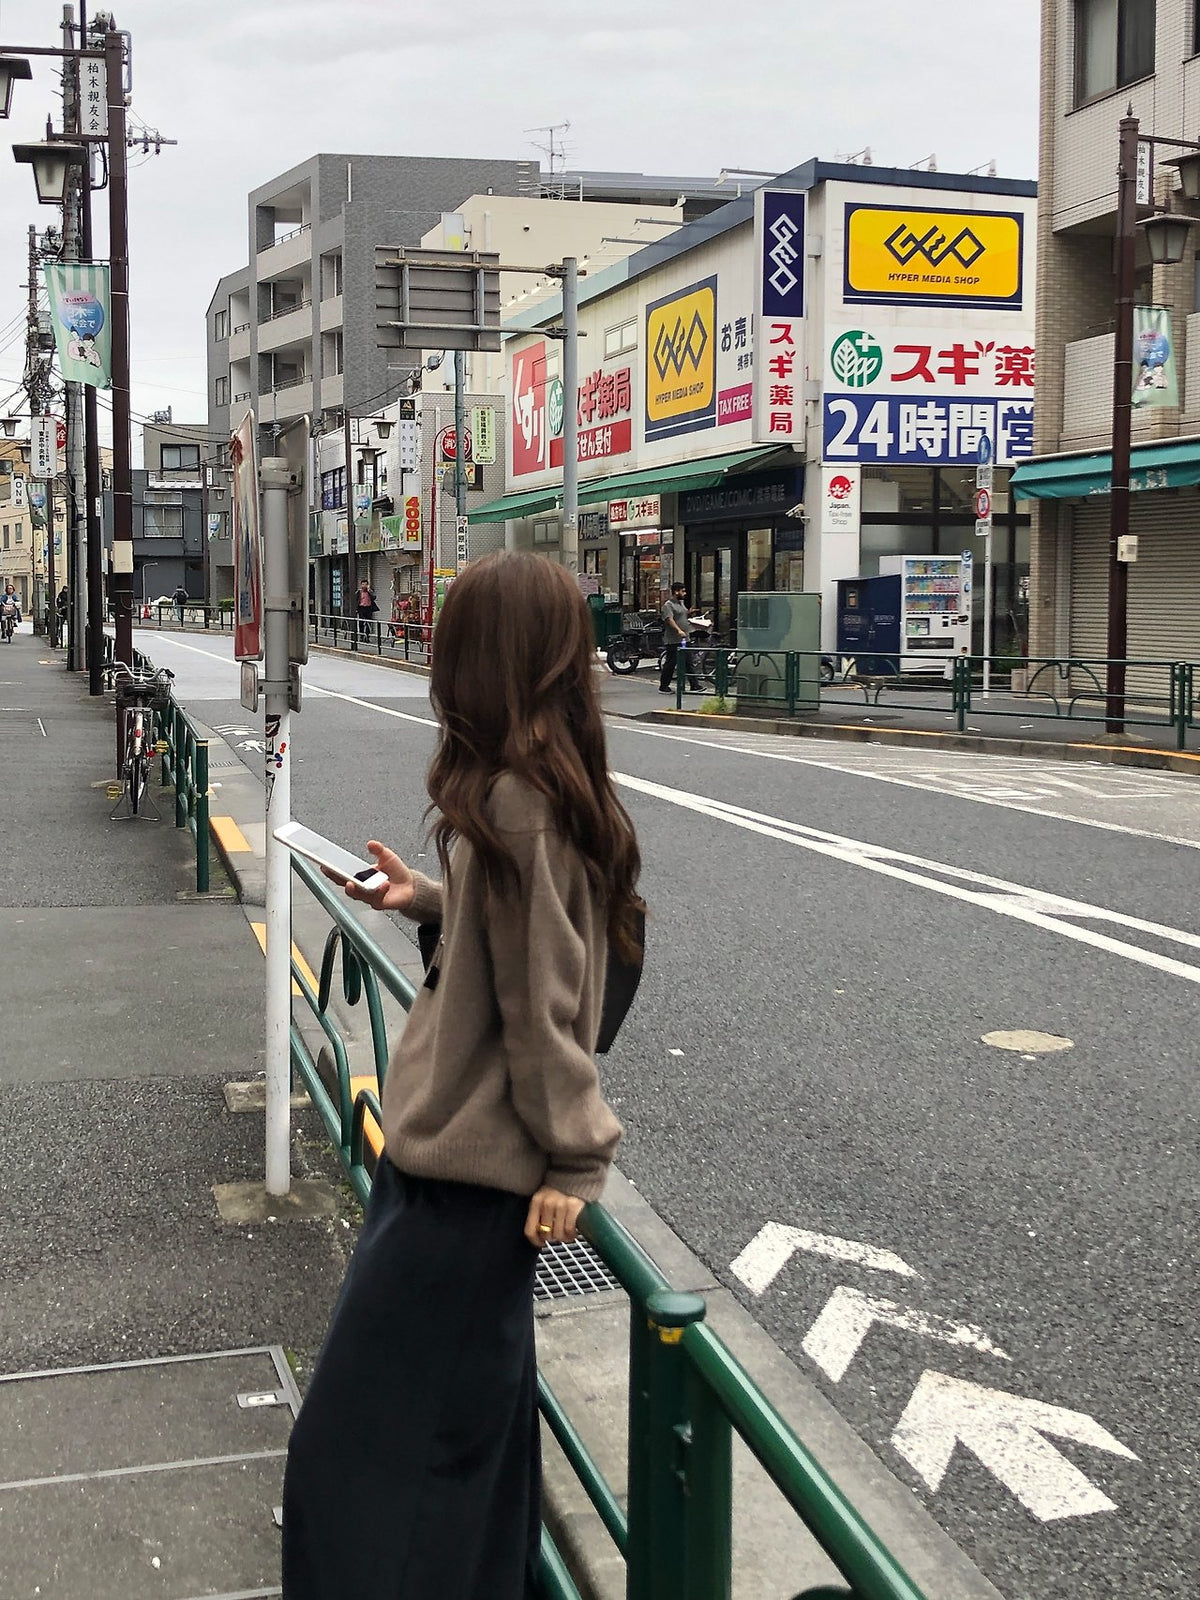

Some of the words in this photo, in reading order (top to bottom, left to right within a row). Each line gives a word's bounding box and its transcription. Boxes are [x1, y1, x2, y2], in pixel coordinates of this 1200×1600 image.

[87, 62, 100, 131] 柏木親友会
[768, 213, 799, 297] GEO
[884, 223, 987, 269] GEO
[888, 273, 919, 282] HYPER
[922, 274, 951, 284] MEDIA
[954, 275, 980, 285] SHOP
[653, 309, 708, 382] GEO
[577, 368, 631, 426] ギ薬局
[655, 391, 671, 405] HYPER
[672, 387, 688, 400] MEDIA
[689, 382, 704, 397] SHOP
[769, 324, 796, 434] スギ薬局
[514, 358, 545, 463] くすり
[719, 399, 733, 417] TAX
[733, 394, 750, 413] FREE
[406, 496, 420, 542] 400円
[635, 500, 660, 518] スギ薬局
[832, 518, 848, 526] Shop
